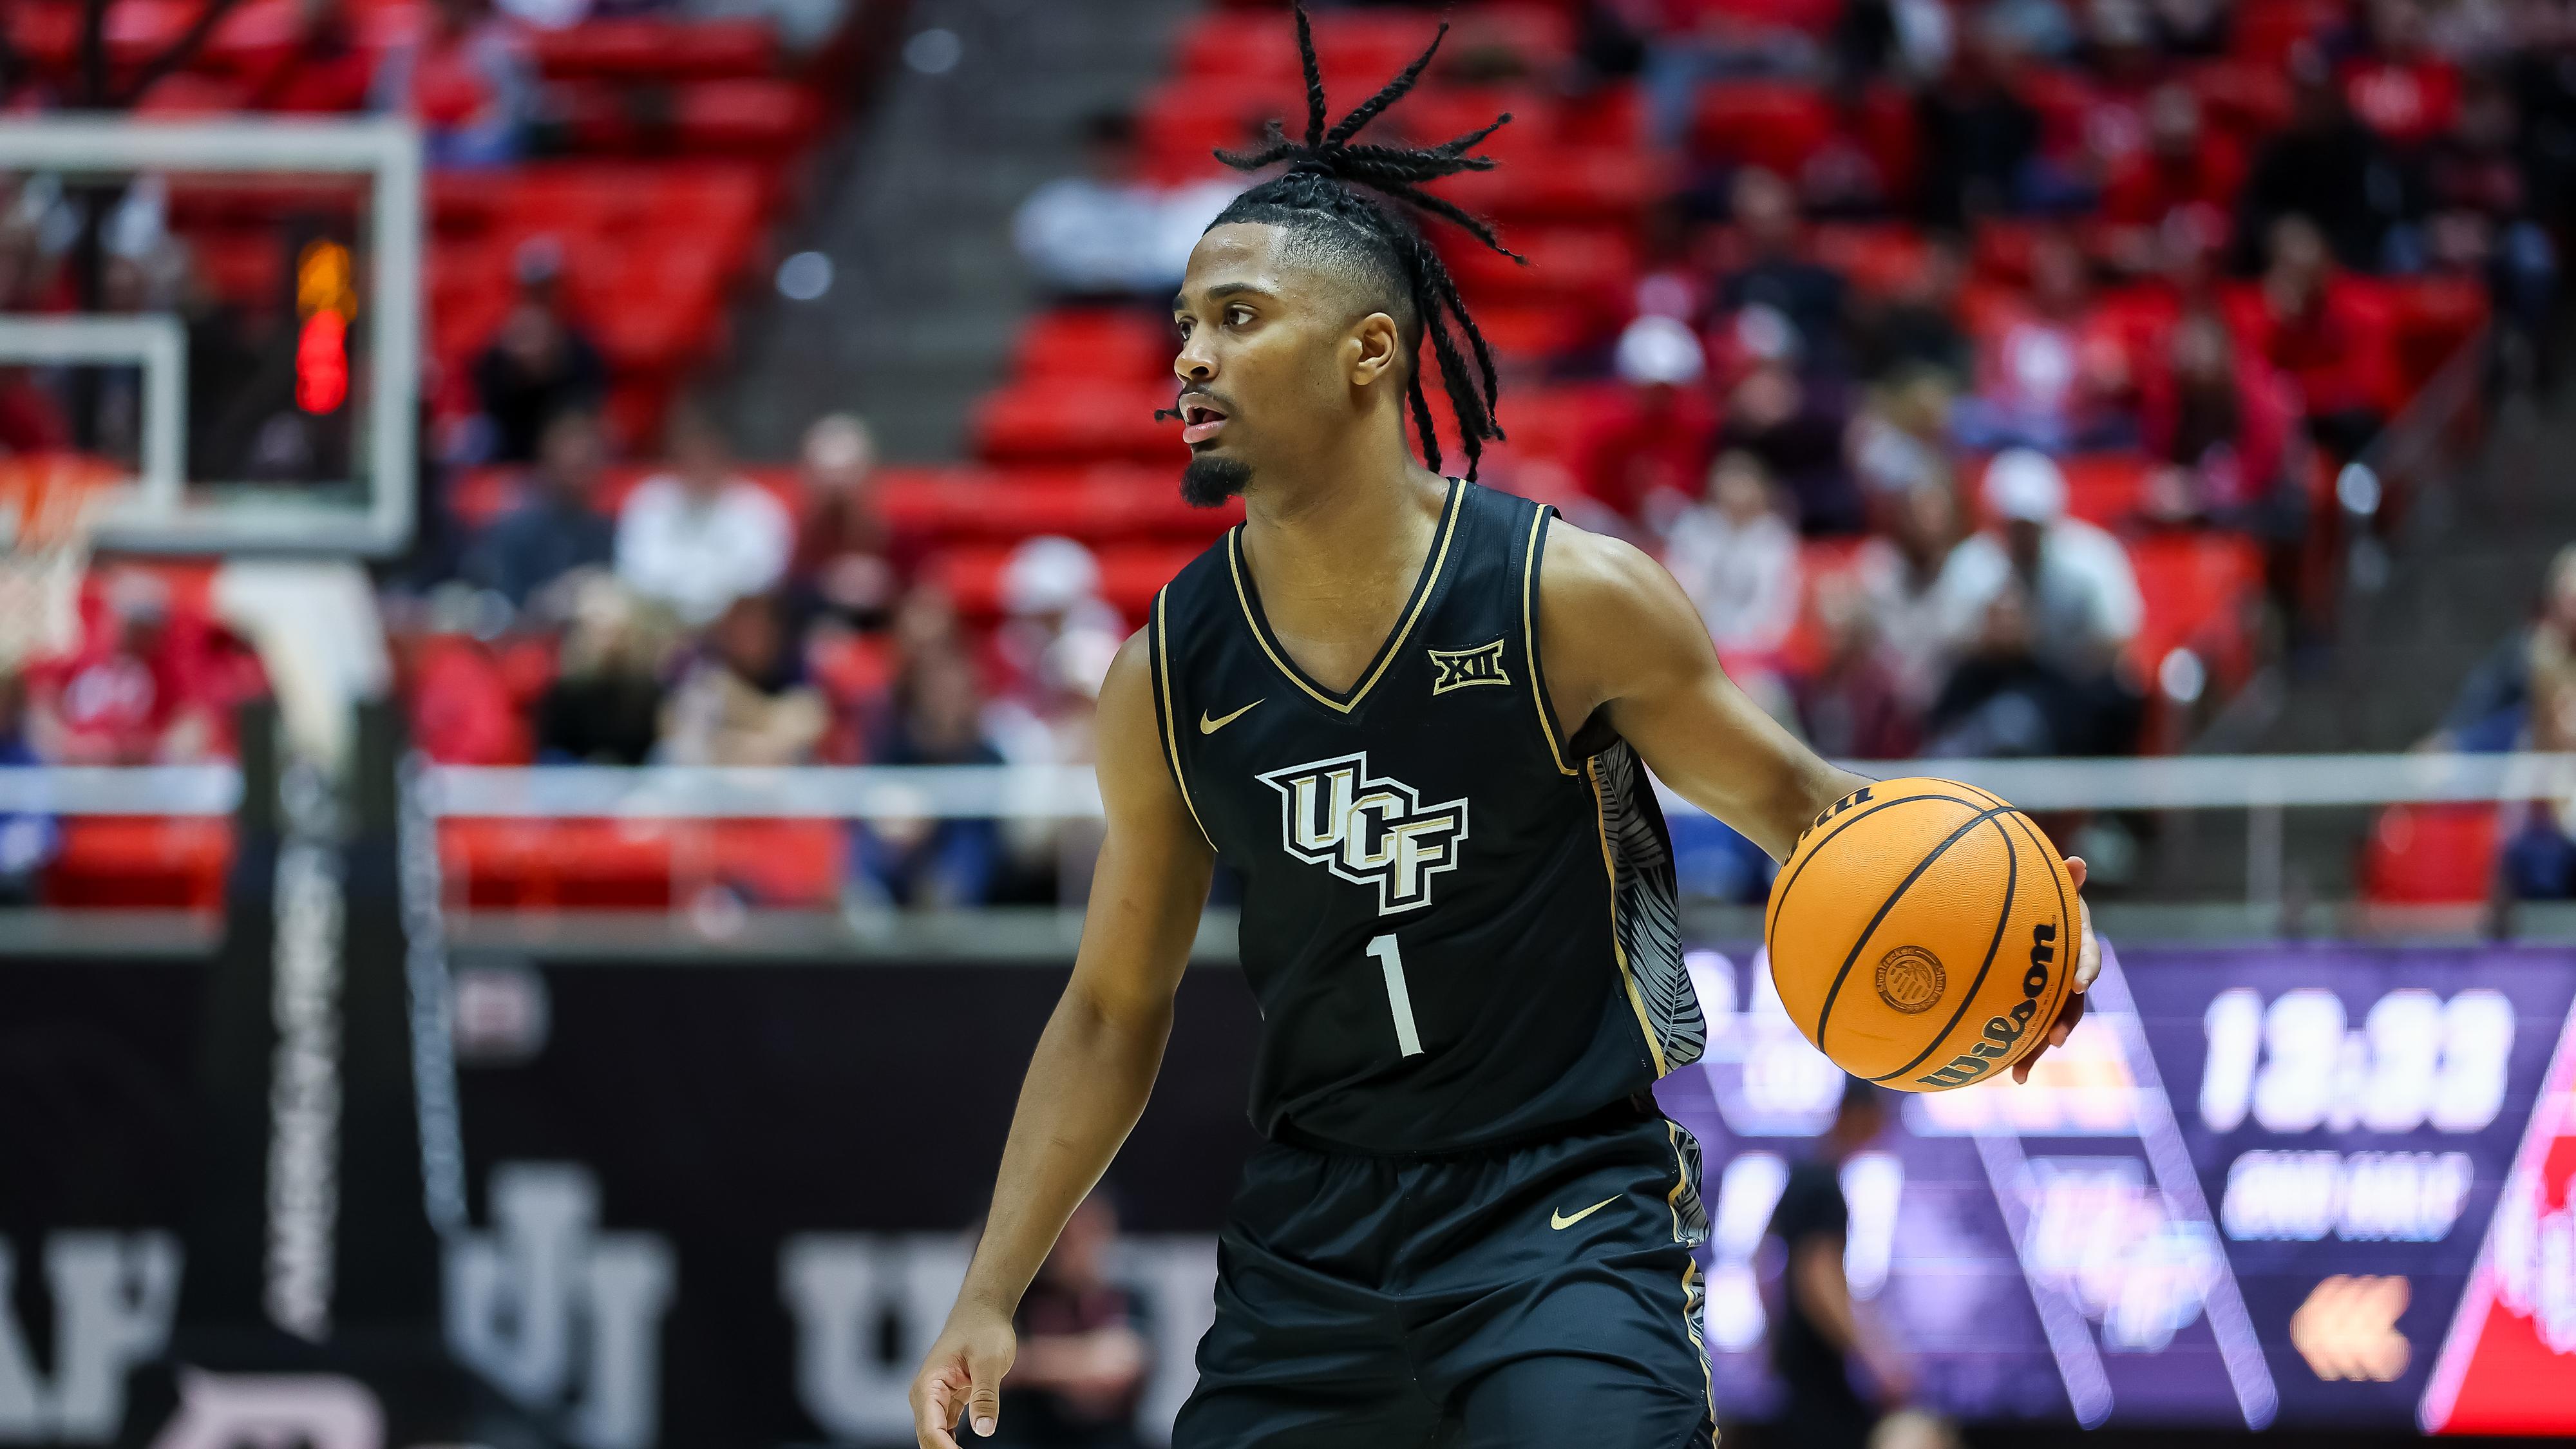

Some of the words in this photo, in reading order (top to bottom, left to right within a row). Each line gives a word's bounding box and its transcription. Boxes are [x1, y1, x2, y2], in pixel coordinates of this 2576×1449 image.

[1256, 751, 1468, 915] UCF
[1366, 933, 1425, 1058] 1
[1915, 923, 2057, 1088] Wilson
